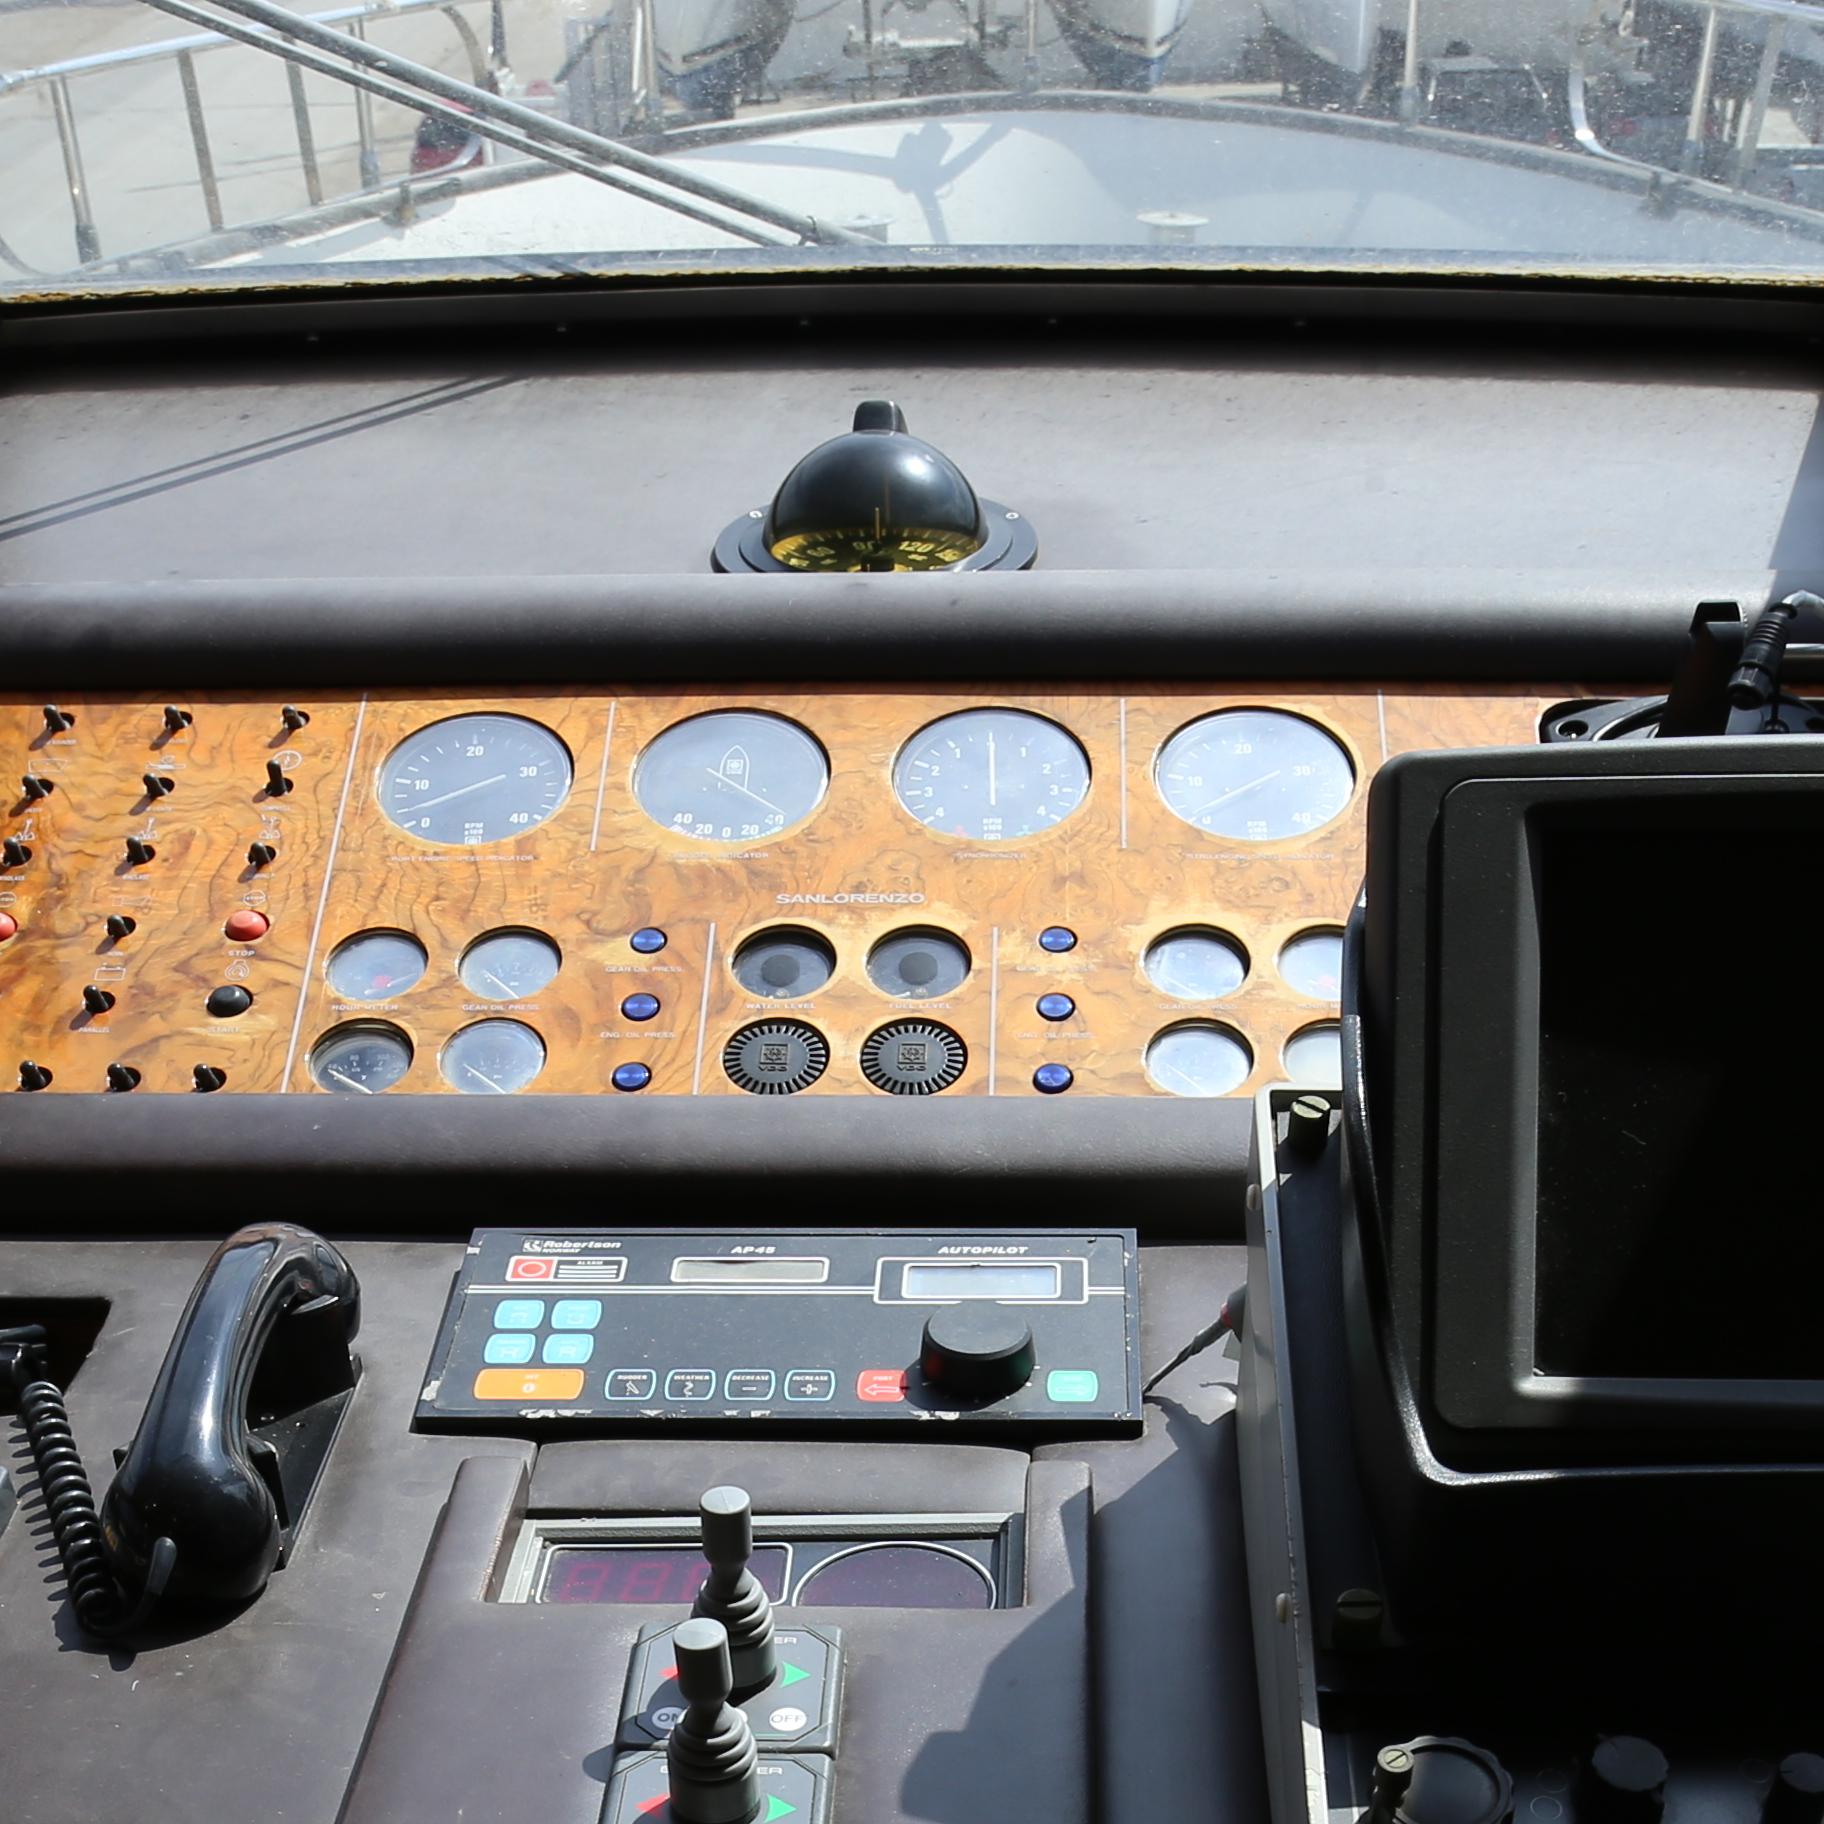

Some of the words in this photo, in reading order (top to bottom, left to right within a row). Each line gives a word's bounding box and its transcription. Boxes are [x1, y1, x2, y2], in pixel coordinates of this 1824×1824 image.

[898, 541, 935, 553] 120
[466, 746, 484, 757] 20
[955, 748, 961, 758] 1
[1020, 747, 1026, 757] 1
[1234, 743, 1252, 754] 20
[520, 766, 537, 777] 30
[931, 766, 940, 776] 2
[1042, 763, 1052, 774] 2
[1293, 765, 1311, 776] 30
[414, 780, 429, 790] 10
[1187, 776, 1202, 787] 10
[924, 786, 933, 798] 3
[1049, 784, 1059, 796] 3
[935, 807, 944, 817] 4
[1037, 805, 1046, 816] 4
[421, 817, 430, 828] 0
[509, 812, 528, 823] 40
[673, 812, 693, 823] 40
[764, 814, 784, 825] 40
[1291, 812, 1311, 824] 40
[695, 823, 713, 834] 20
[722, 827, 731, 838] 0
[741, 825, 759, 836] 20
[776, 893, 926, 904] SANLORENZO
[543, 1240, 622, 1249] Robertson
[730, 1246, 776, 1254] AP45
[938, 1246, 1028, 1254] AUTOPILOT
[771, 1714, 805, 1723] OFF
